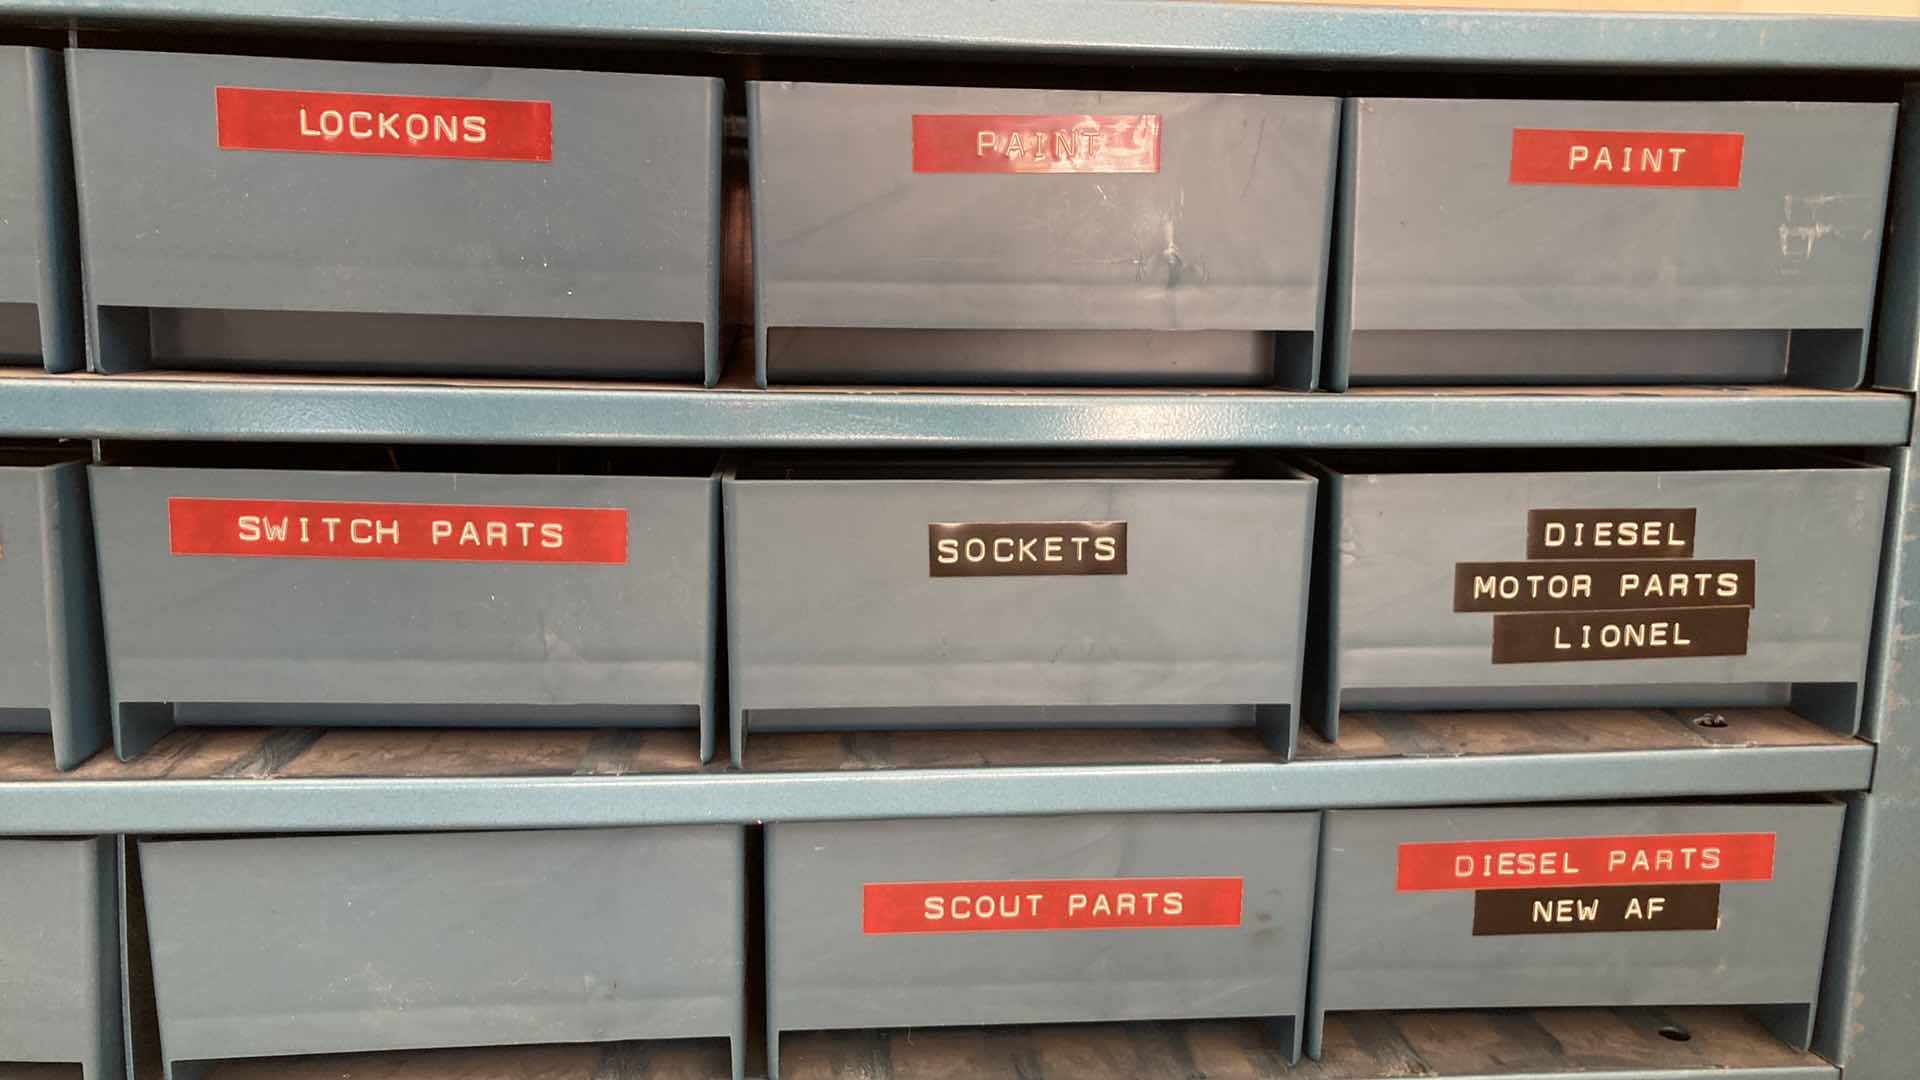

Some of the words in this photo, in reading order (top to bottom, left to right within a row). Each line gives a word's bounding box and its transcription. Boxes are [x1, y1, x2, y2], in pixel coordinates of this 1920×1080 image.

[299, 108, 488, 143] LOCKONS
[976, 130, 1102, 158] PAINT
[1568, 145, 1687, 173] PAINT
[238, 515, 400, 546] SWITCH
[431, 519, 564, 549] PARTS
[1544, 521, 1686, 547] DIESEL
[937, 536, 1116, 564] SOCKETS
[1473, 574, 1593, 600] MOTOR
[1619, 572, 1740, 598] PARTS
[1553, 622, 1692, 650] LIONEL
[1454, 851, 1580, 878] DIESEL
[1607, 847, 1721, 873] PARTS
[923, 893, 1044, 920] SCOUT
[1068, 891, 1185, 918] PARTS
[1532, 898, 1600, 923] NEW
[1623, 896, 1667, 921] AF
